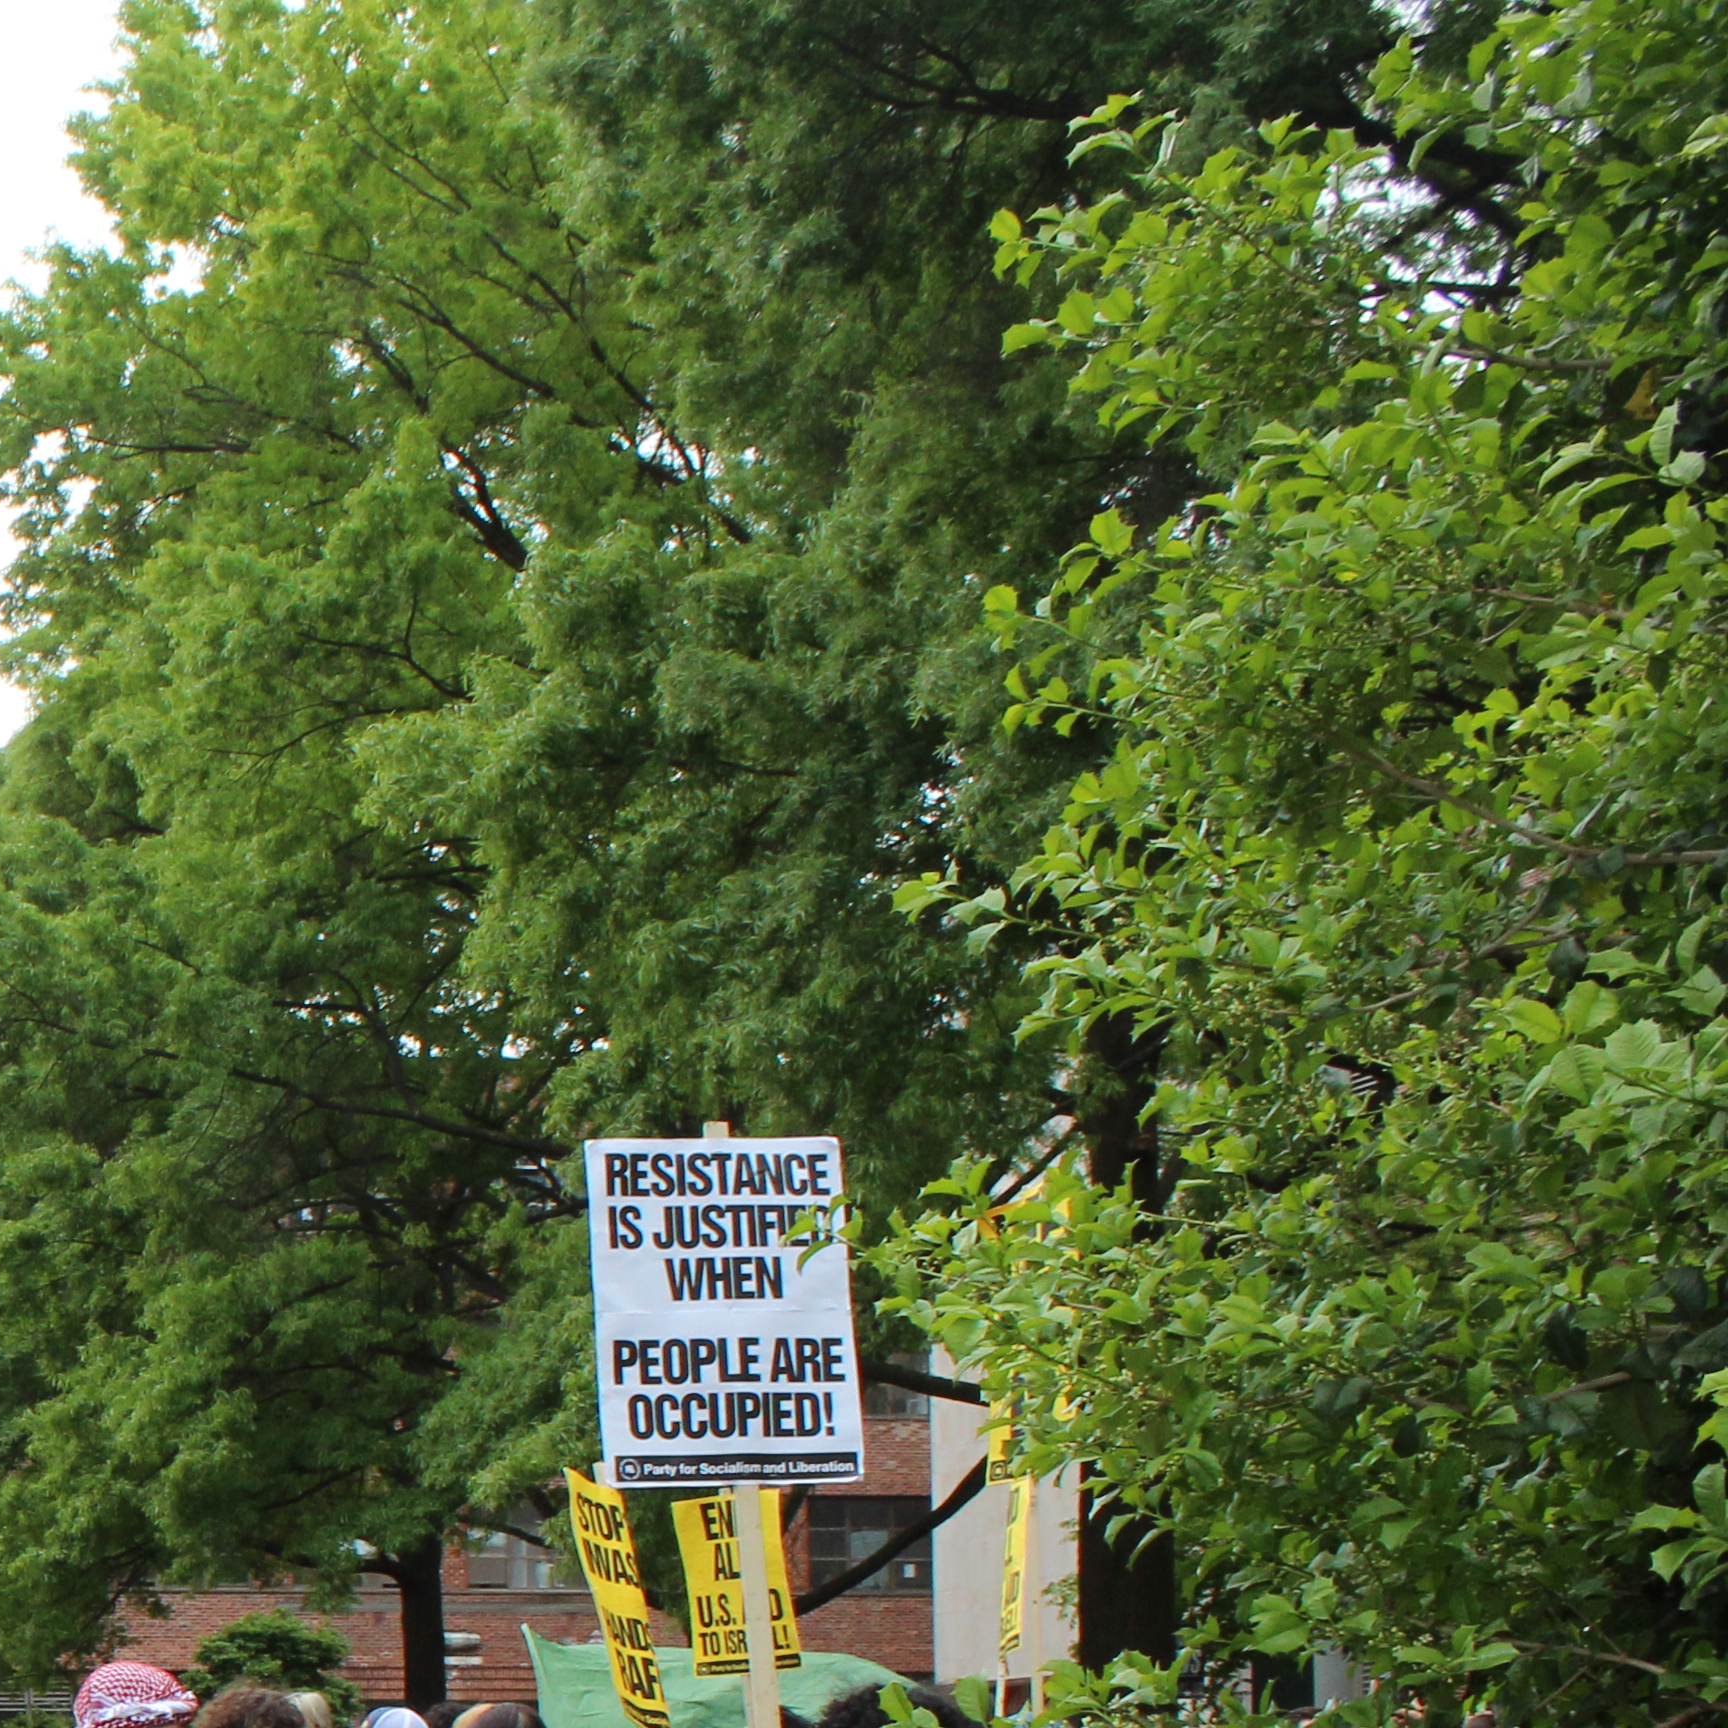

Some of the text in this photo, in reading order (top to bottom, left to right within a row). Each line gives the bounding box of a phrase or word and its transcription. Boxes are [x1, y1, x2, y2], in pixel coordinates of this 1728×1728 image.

[604, 1153, 831, 1197] RESISTANCE
[608, 1205, 643, 1250] IS
[664, 1256, 784, 1301] WHEN
[612, 1337, 846, 1385] PEOPLE ARE
[627, 1392, 836, 1440] OCCUPIED!
[643, 1463, 676, 1477] Party
[678, 1462, 697, 1474] for
[699, 1461, 762, 1475] Socialism
[762, 1461, 785, 1473] and
[787, 1460, 855, 1473] Liberation
[697, 1593, 737, 1628] U.S.
[698, 1631, 721, 1656] TO
